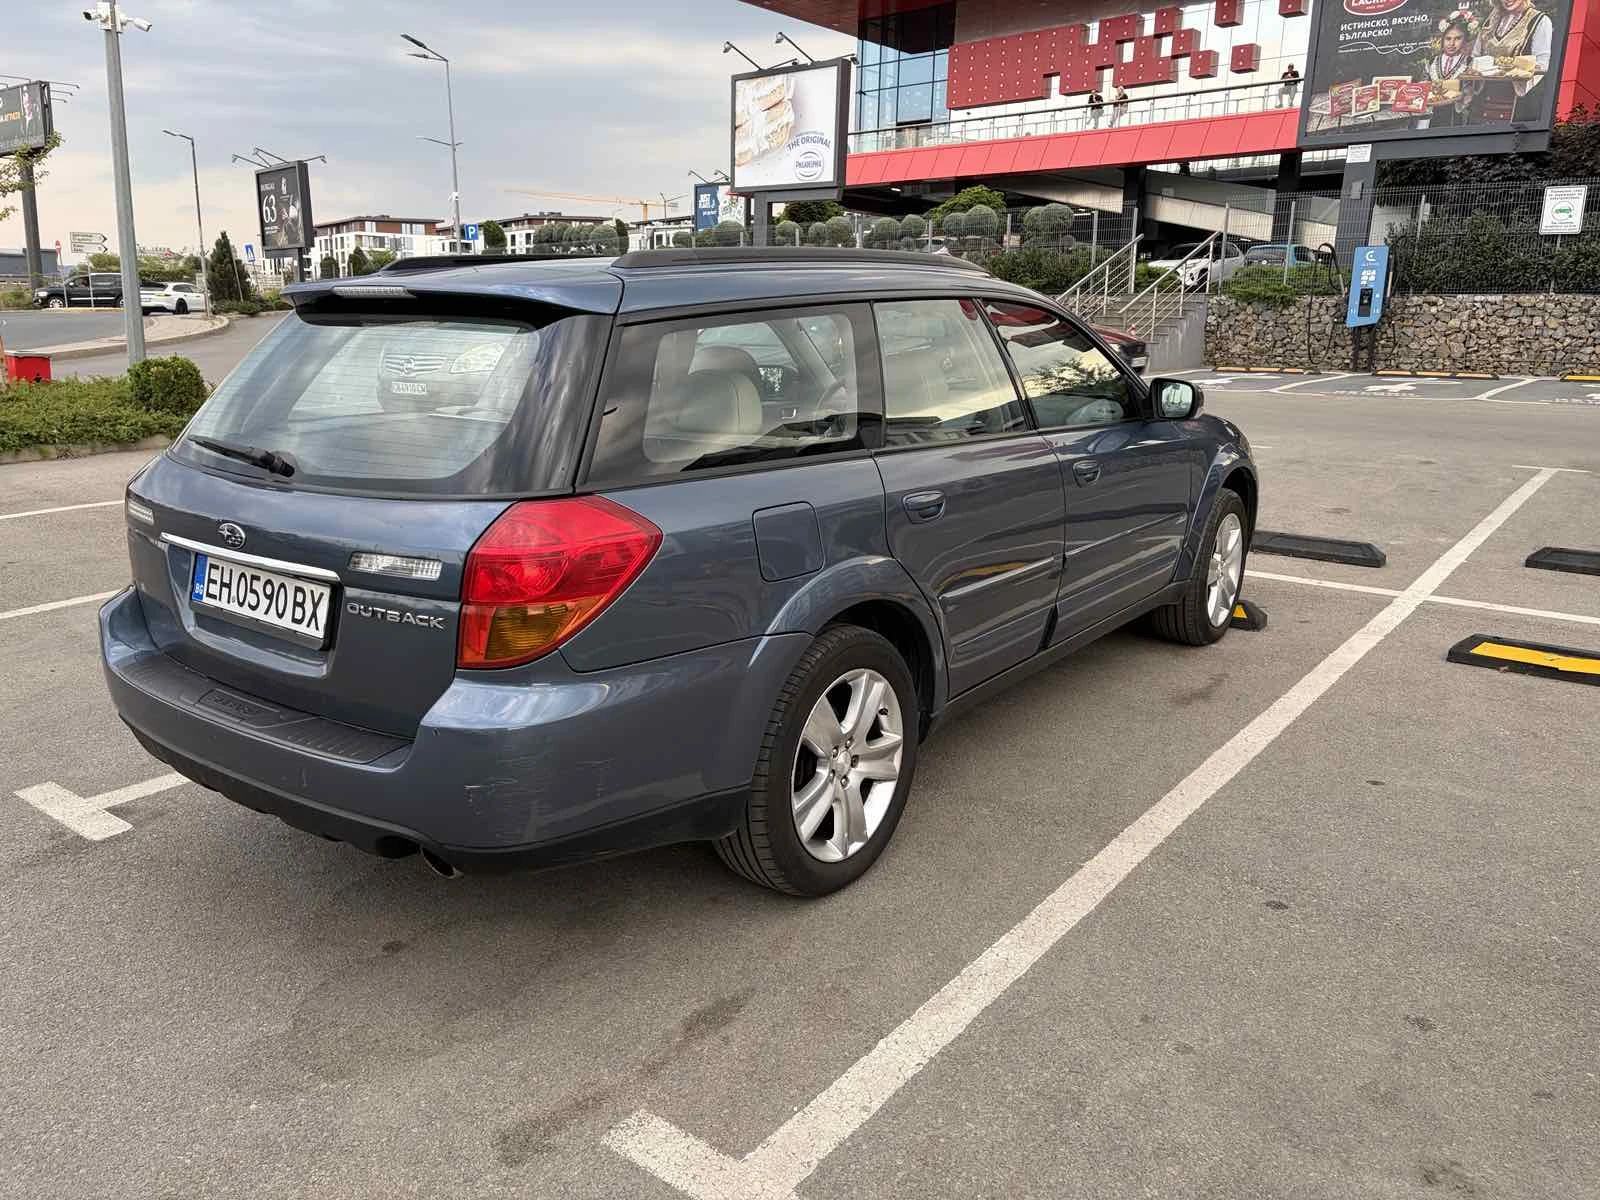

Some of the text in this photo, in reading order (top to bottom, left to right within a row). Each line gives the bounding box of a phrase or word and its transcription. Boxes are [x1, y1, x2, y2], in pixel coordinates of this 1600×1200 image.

[1340, 14, 1430, 31] ИСТИНСКО, ВКУСНО,
[1339, 28, 1393, 40] БЪЛГАРСКО!
[786, 135, 832, 152] THE ORIGINAL
[262, 194, 278, 224] 63
[468, 226, 476, 239] P
[346, 602, 445, 629] OUTBACK
